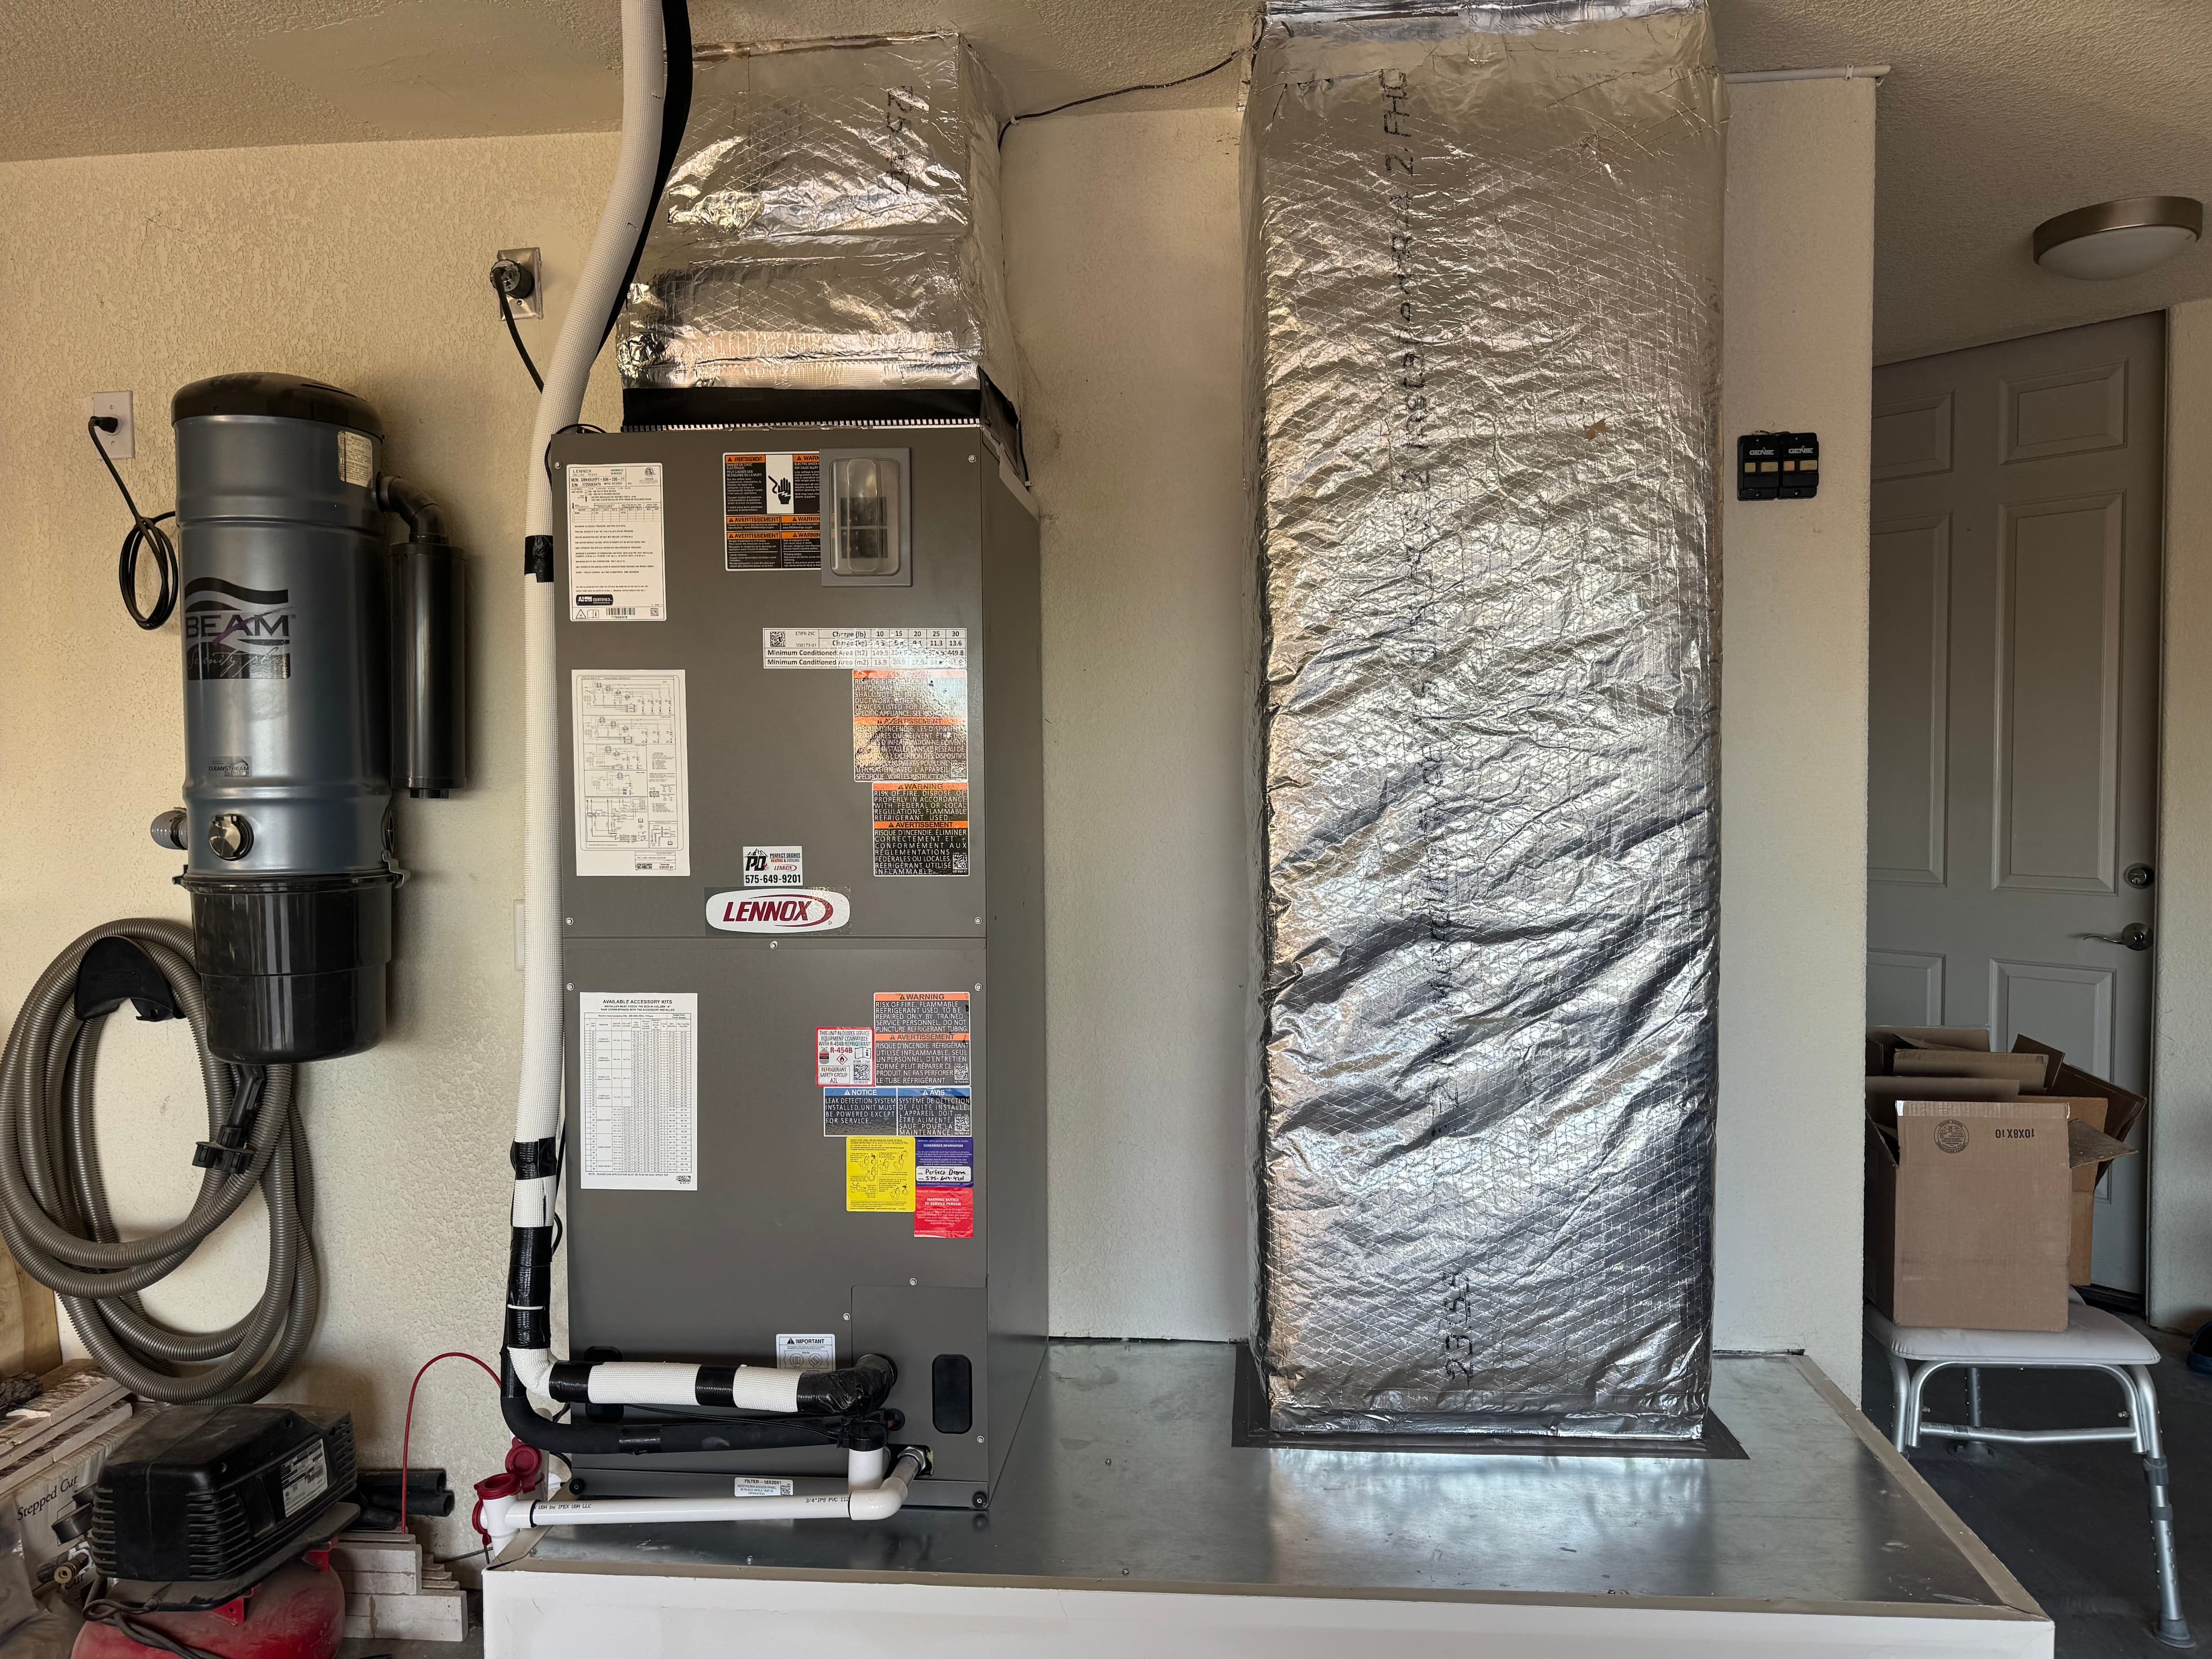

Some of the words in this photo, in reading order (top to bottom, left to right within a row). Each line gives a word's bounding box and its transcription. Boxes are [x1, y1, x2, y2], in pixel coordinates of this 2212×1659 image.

[1789, 446, 1813, 454] GENIE
[185, 615, 289, 638] BEAM
[745, 874, 801, 883] 575-649-9201
[723, 900, 812, 922] LENNOX
[18, 1486, 57, 1521] Stepped
